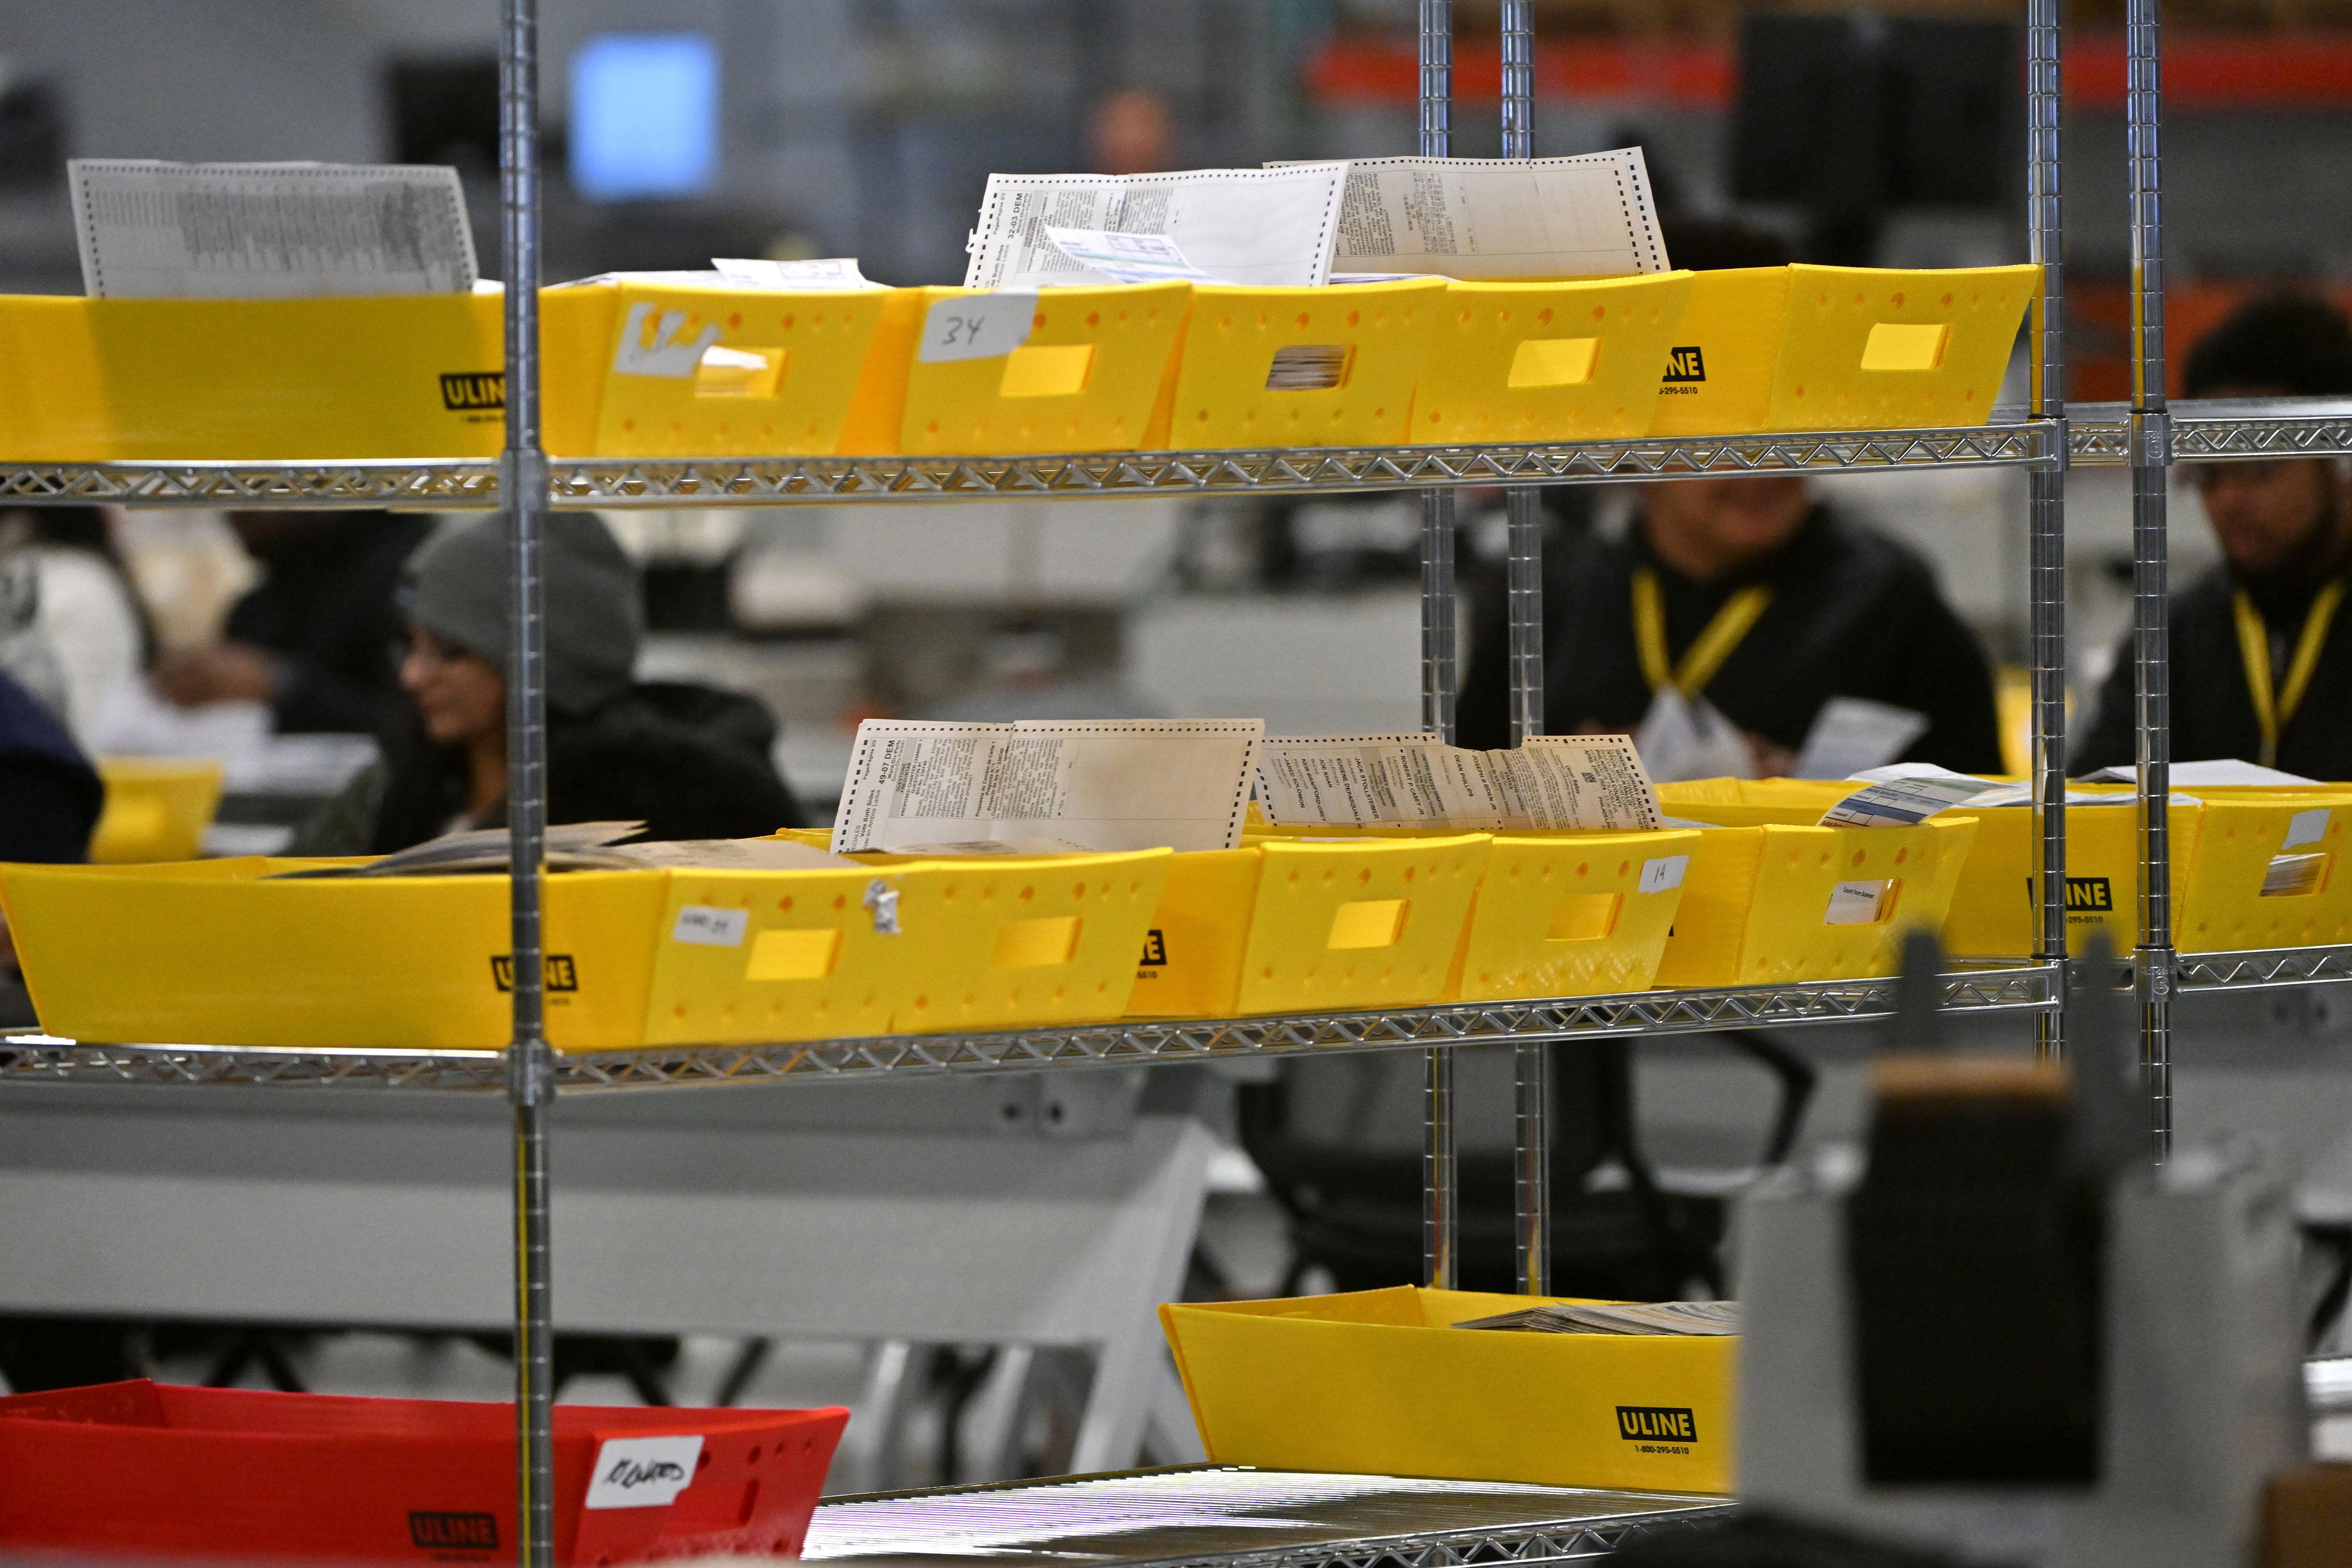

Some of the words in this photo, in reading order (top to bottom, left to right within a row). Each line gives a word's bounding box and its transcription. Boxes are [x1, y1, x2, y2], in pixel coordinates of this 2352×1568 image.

[1008, 216, 1017, 238] 32-03
[1013, 193, 1022, 212] DEM
[942, 315, 985, 345] 34
[445, 377, 506, 406] ULIN
[863, 748, 874, 779] Page/Página
[879, 763, 889, 784] 49-07
[884, 740, 894, 759] DEM
[887, 740, 901, 778] Ward-Div-Party
[1310, 759, 1319, 774] BUCKS
[1329, 758, 1340, 785] ALLEGHENY
[1346, 758, 1358, 784] DELAWARE
[1392, 756, 1405, 789] LACKAWANNA
[1565, 765, 1574, 777] Omar
[1584, 750, 1594, 763] APRIL
[1615, 749, 1629, 771] GENERAL
[1627, 774, 1639, 795] PRIMARY
[896, 763, 906, 791] QUESTIONS
[901, 763, 910, 792] PREGUNTAS
[901, 789, 910, 816] PROPOSED
[907, 765, 916, 787] CHARTER
[911, 768, 920, 793] QUESTION
[1284, 758, 1295, 777] JARED
[1292, 778, 1305, 808] SOLOMON
[1301, 758, 1310, 771] KEIR
[1307, 773, 1326, 822] BRADFORD-GREY
[1323, 772, 1333, 788] KHAN
[1336, 758, 1347, 781] EUGENE
[1344, 783, 1361, 821] DEPASQUALE
[1354, 757, 1363, 773] JACK
[1360, 775, 1379, 818] STOLLSTEIMER
[1370, 764, 1379, 789] Procurador
[1377, 790, 1386, 805] General
[1378, 760, 1388, 786] ATTORNEY
[1386, 787, 1396, 807] GENERAL
[1400, 756, 1412, 780] ROBERT
[1410, 788, 1421, 805] CASEY
[1421, 754, 1429, 771] UNITED
[1427, 773, 1435, 790] STATES
[1433, 791, 1444, 811] SENATOR
[1454, 755, 1463, 771] DEAN
[1460, 773, 1474, 797] PHILLIPS
[1472, 754, 1484, 777] JOSEPH
[1483, 784, 1493, 801] BIDEN
[1499, 752, 1513, 775] PRESIDENT
[1516, 794, 1525, 811] UNITED
[1504, 771, 1513, 789] STATES
[1595, 750, 1615, 782] PHILADELPHIA
[1612, 784, 1622, 807] COUNTY
[1605, 749, 1618, 768] OFFICIAL
[1623, 786, 1632, 805] BALLOT
[1654, 863, 1667, 883] 14
[496, 960, 574, 987] UNE
[1622, 1412, 1692, 1437] ULINE
[1634, 1445, 1690, 1455] 1-800-295-5510
[416, 1518, 493, 1543] ULINE
